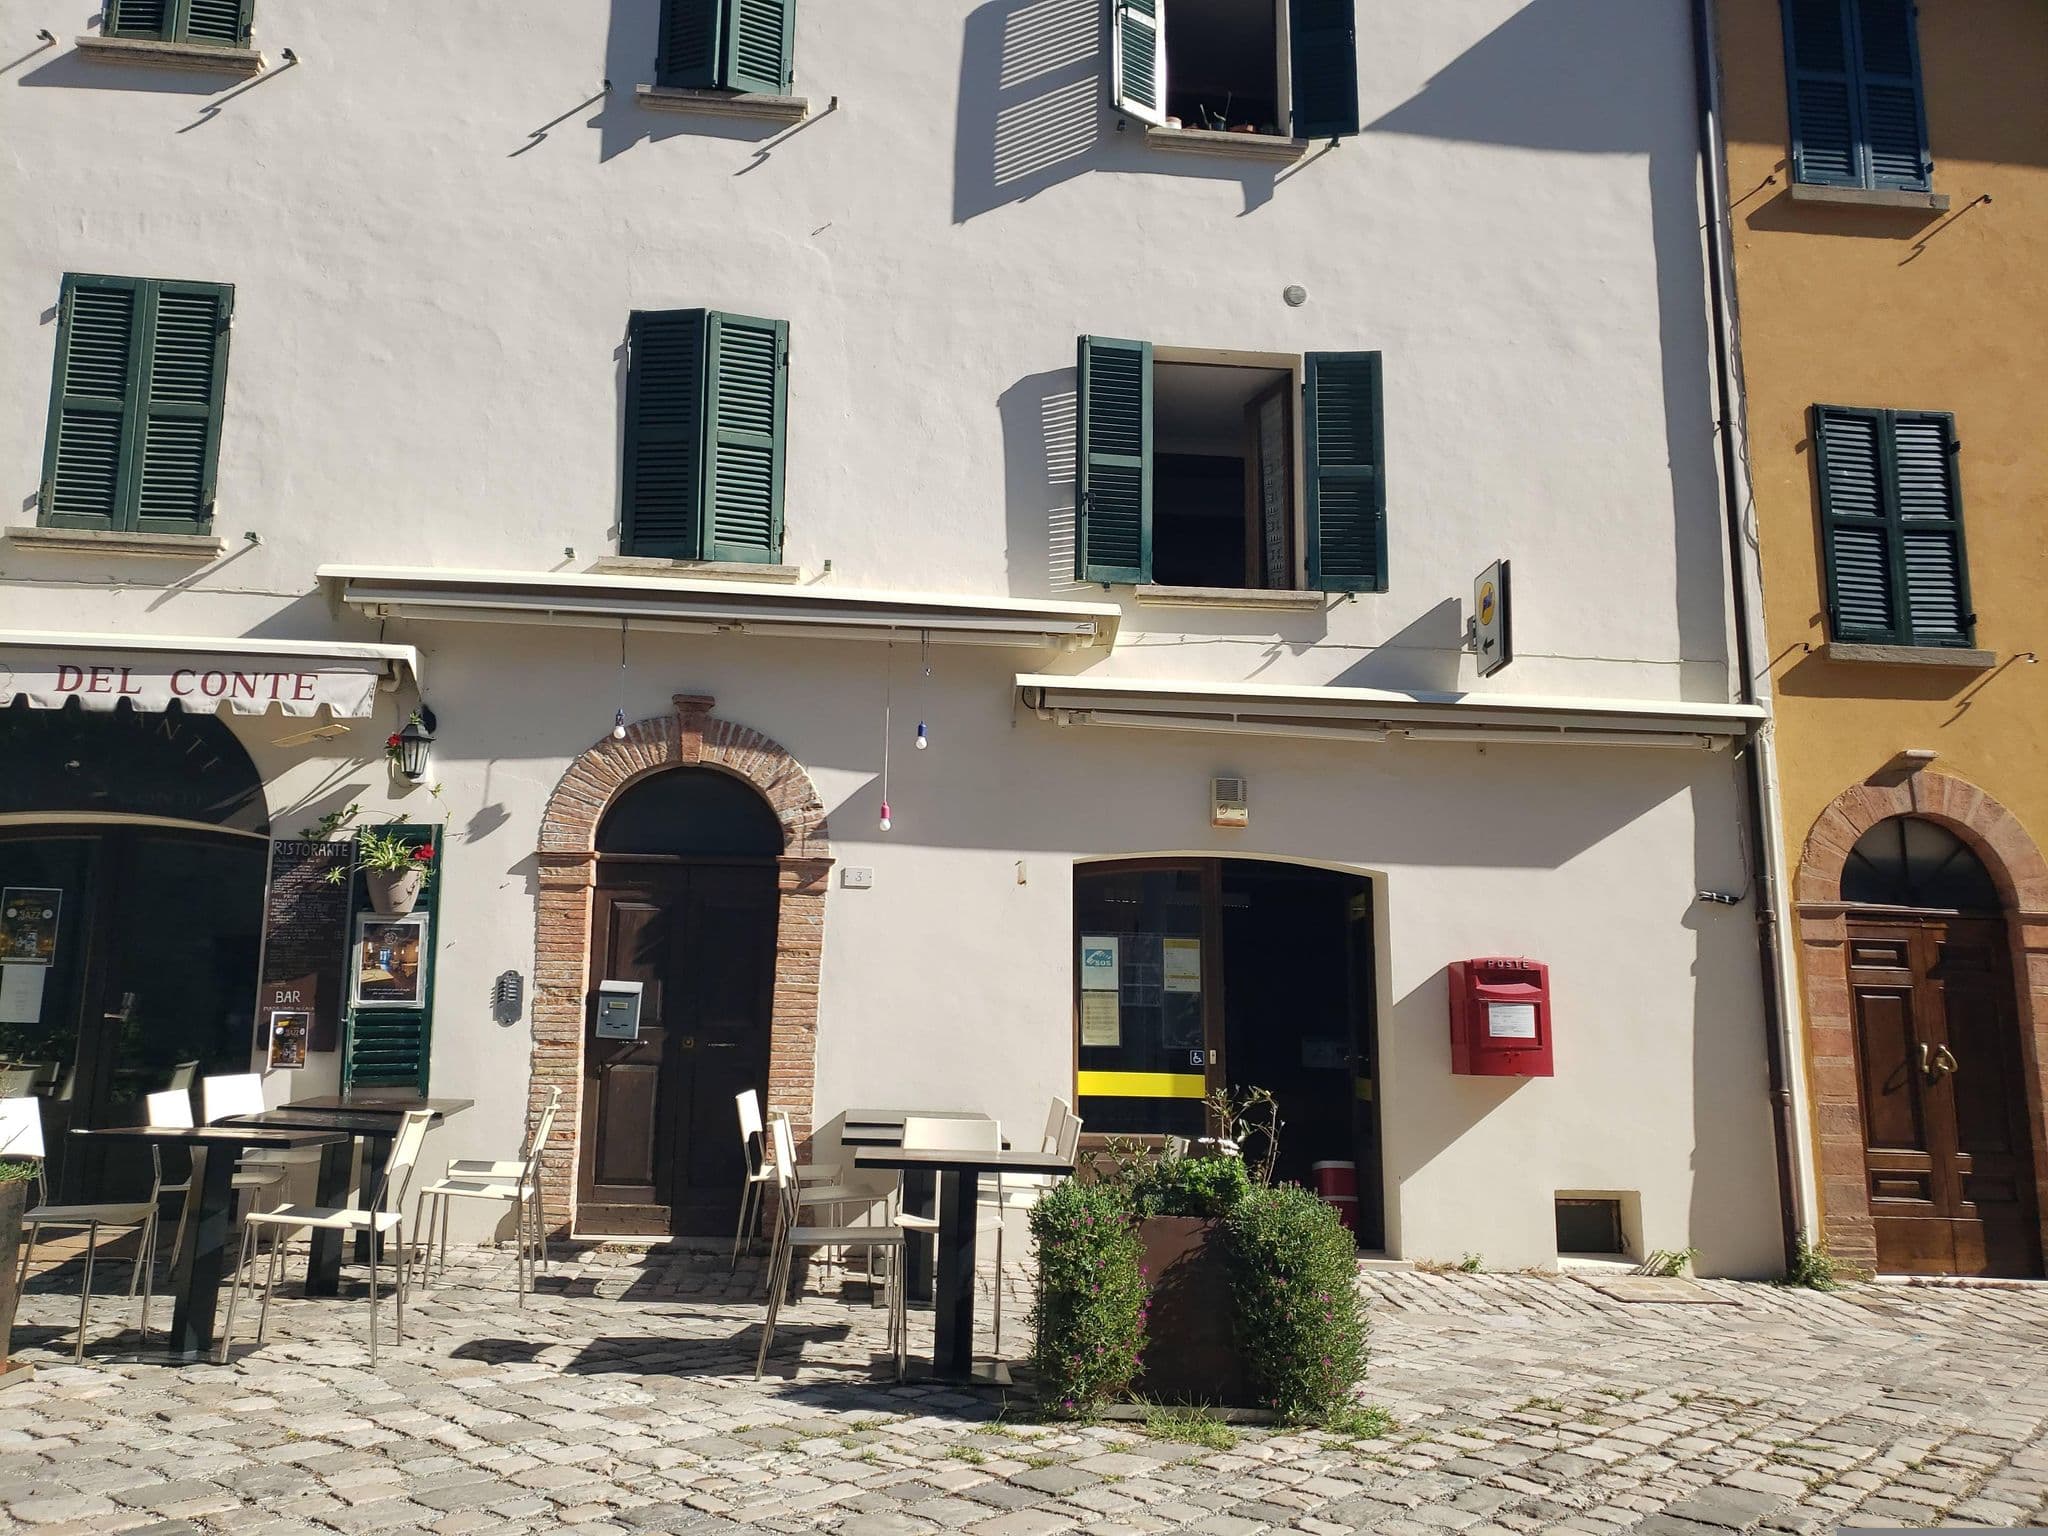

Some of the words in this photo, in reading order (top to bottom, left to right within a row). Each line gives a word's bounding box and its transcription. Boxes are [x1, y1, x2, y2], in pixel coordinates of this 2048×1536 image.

[54, 664, 142, 694] DEL
[170, 669, 318, 700] CONTE
[273, 841, 349, 857] RISTORANTE
[1487, 959, 1530, 969] POSTE
[275, 990, 301, 1004] BAR
